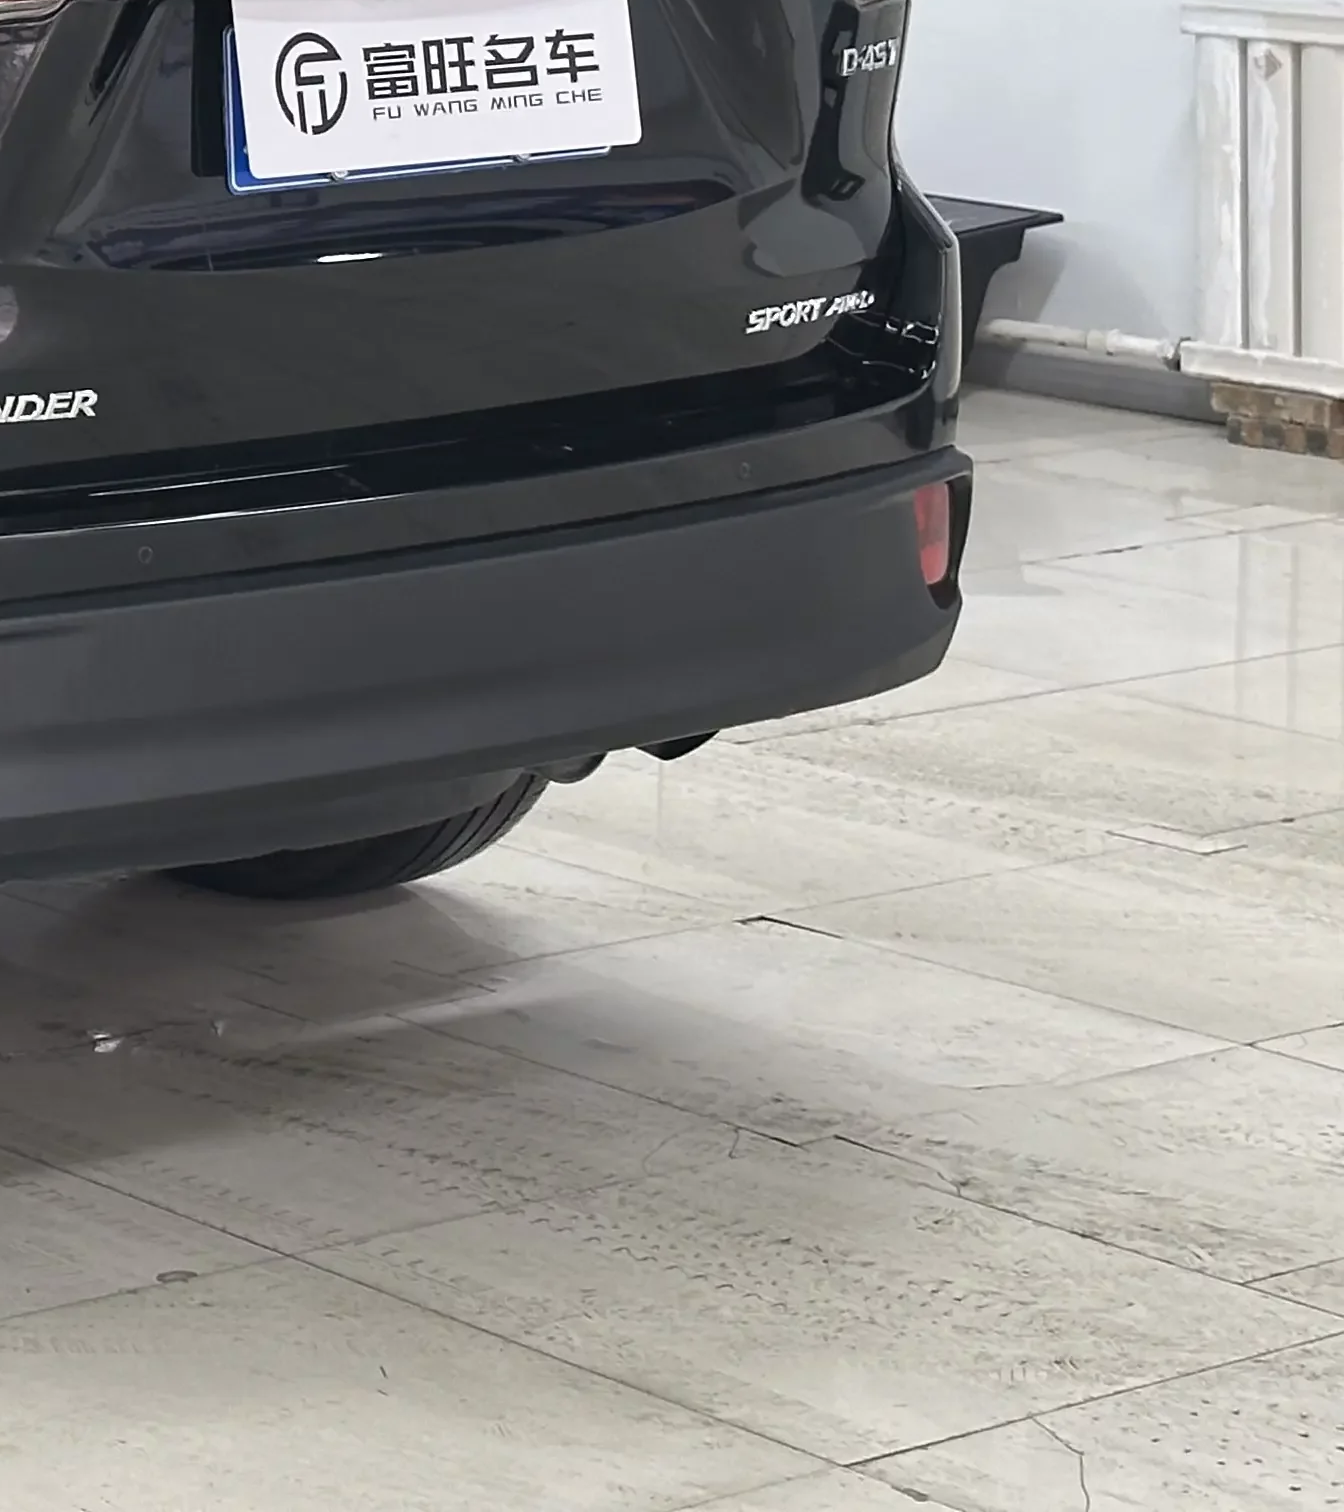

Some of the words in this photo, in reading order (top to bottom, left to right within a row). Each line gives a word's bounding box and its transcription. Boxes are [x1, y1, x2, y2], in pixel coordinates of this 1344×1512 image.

[362, 28, 601, 101] 富旺名车
[372, 105, 402, 121] FU
[414, 99, 479, 117] WANG
[490, 93, 544, 111] MING
[555, 88, 603, 105] CHE
[745, 297, 827, 334] SPORT
